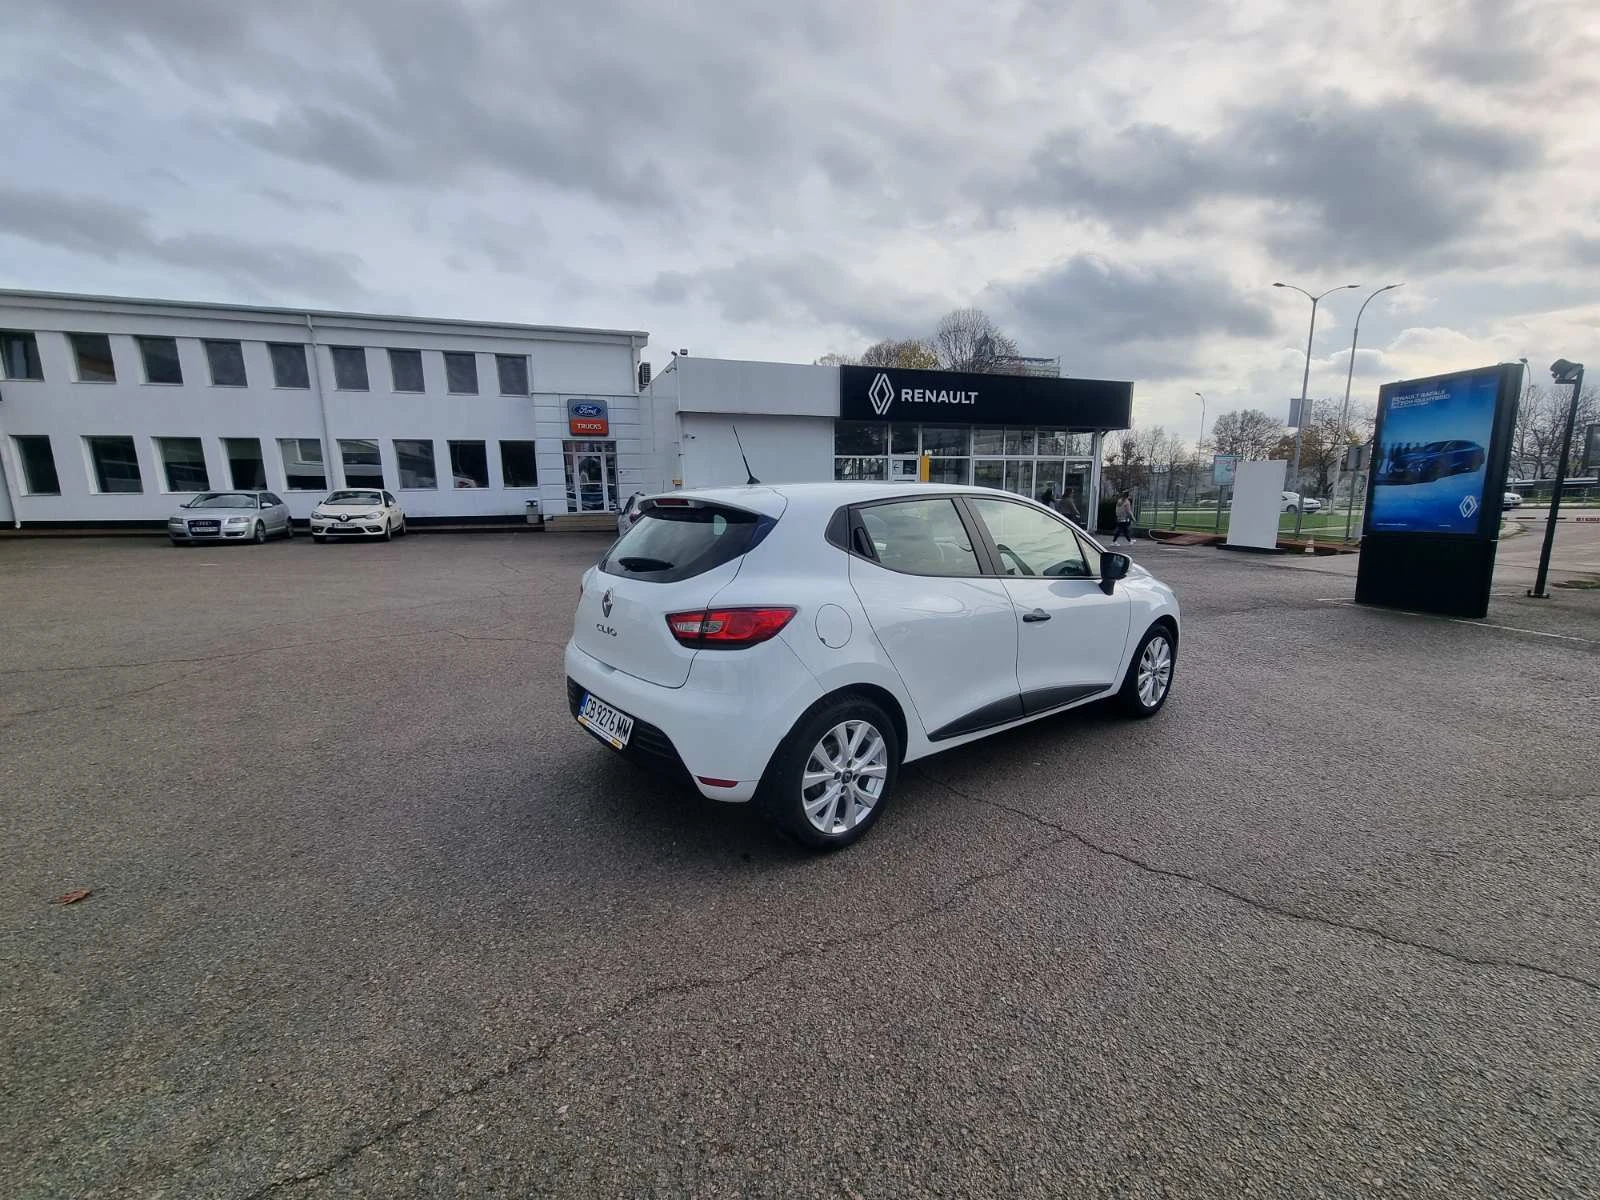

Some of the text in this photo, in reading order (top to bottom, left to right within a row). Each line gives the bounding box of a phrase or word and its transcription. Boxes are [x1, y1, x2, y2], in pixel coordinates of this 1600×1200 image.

[901, 388, 979, 404] RENAULT
[579, 405, 598, 415] Ford
[596, 623, 618, 637] CLIO
[585, 698, 597, 719] CB
[596, 704, 616, 732] 9276
